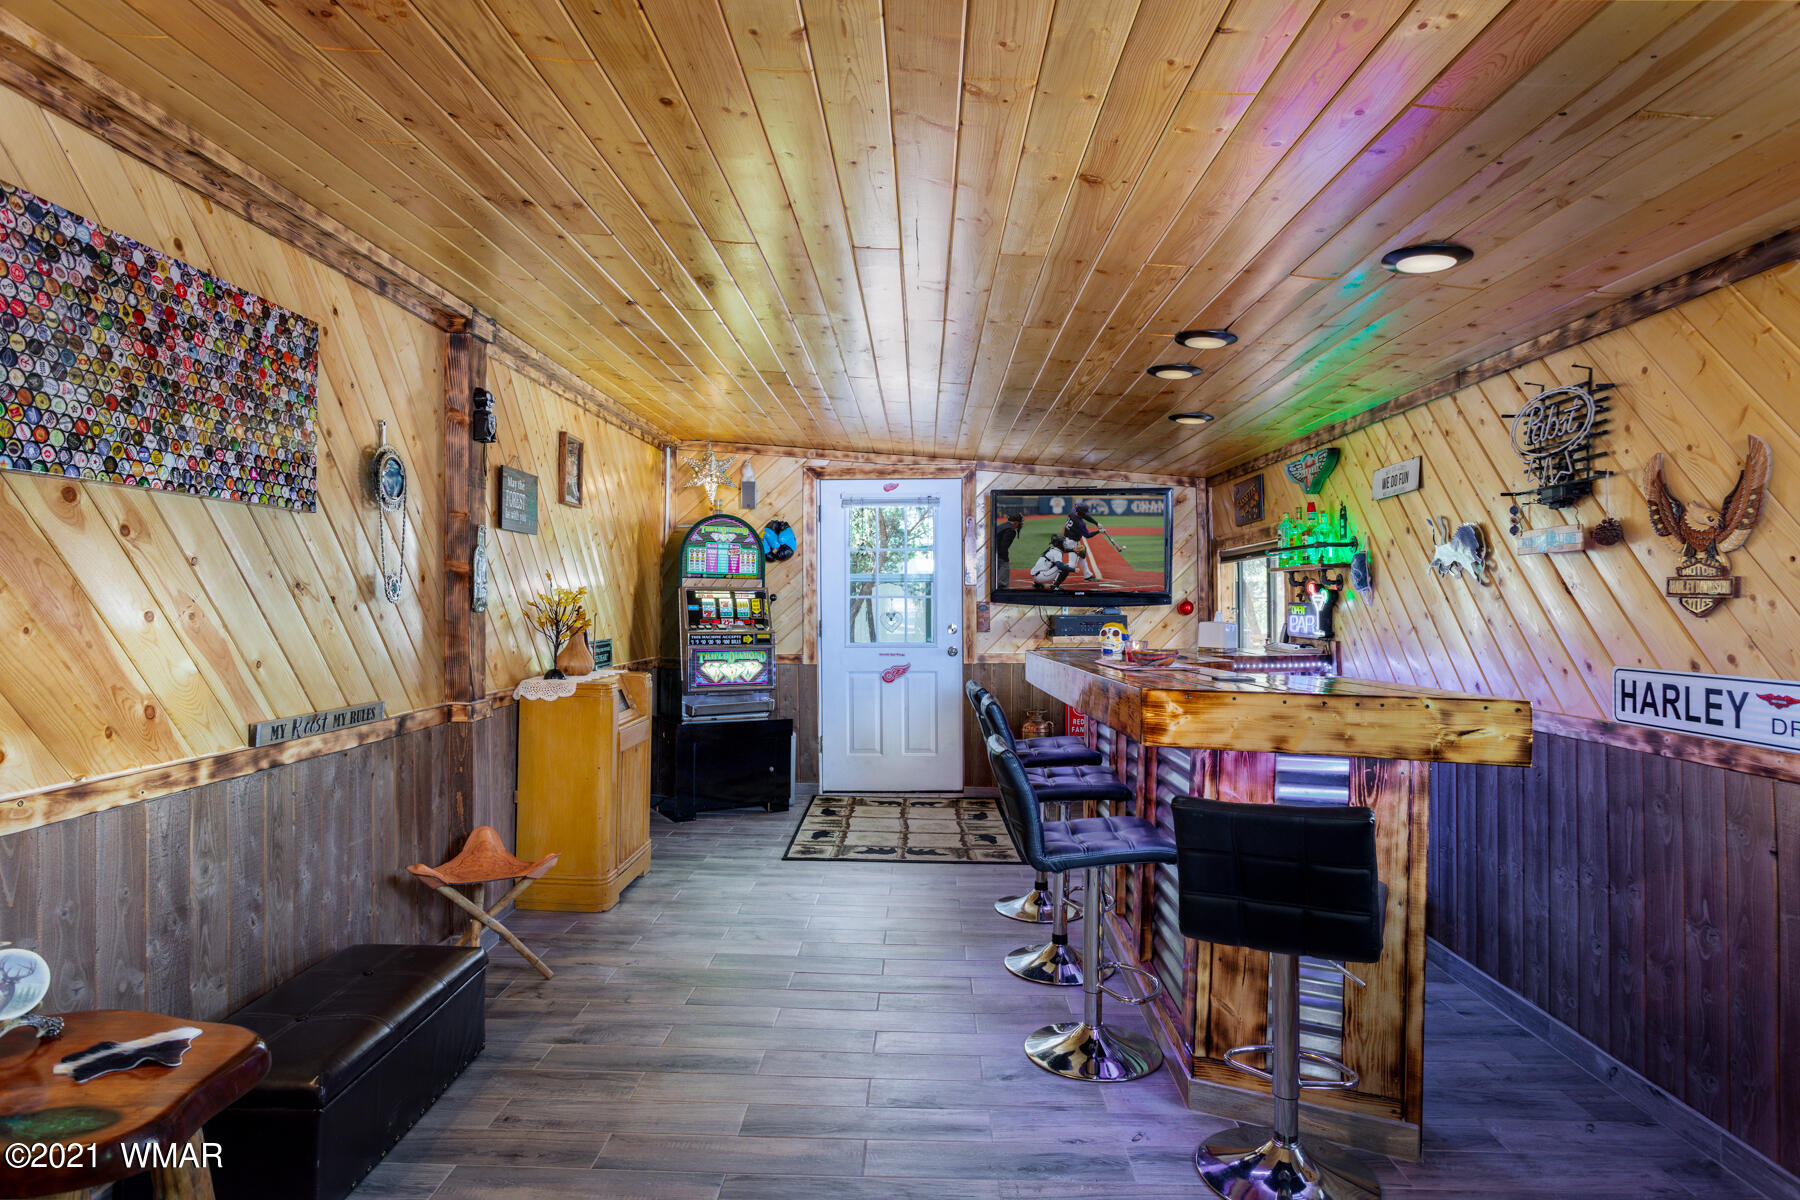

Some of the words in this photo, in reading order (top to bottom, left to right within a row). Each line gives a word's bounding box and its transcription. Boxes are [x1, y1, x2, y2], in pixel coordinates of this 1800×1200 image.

[1525, 398, 1579, 445] Pabst
[507, 475, 517, 491] May
[1391, 474, 1398, 488] DO
[1399, 470, 1409, 486] FUN
[700, 526, 721, 534] TRIPLE
[722, 527, 749, 536] DIAMOND
[1682, 563, 1717, 577] MOTOR
[1289, 615, 1315, 633] BAR
[697, 652, 727, 664] TRIPLE
[727, 651, 767, 663] DIAMOND
[1620, 678, 1749, 729] HARLEY
[270, 724, 288, 741] MY
[332, 712, 348, 729] MY
[350, 706, 376, 724] RULES
